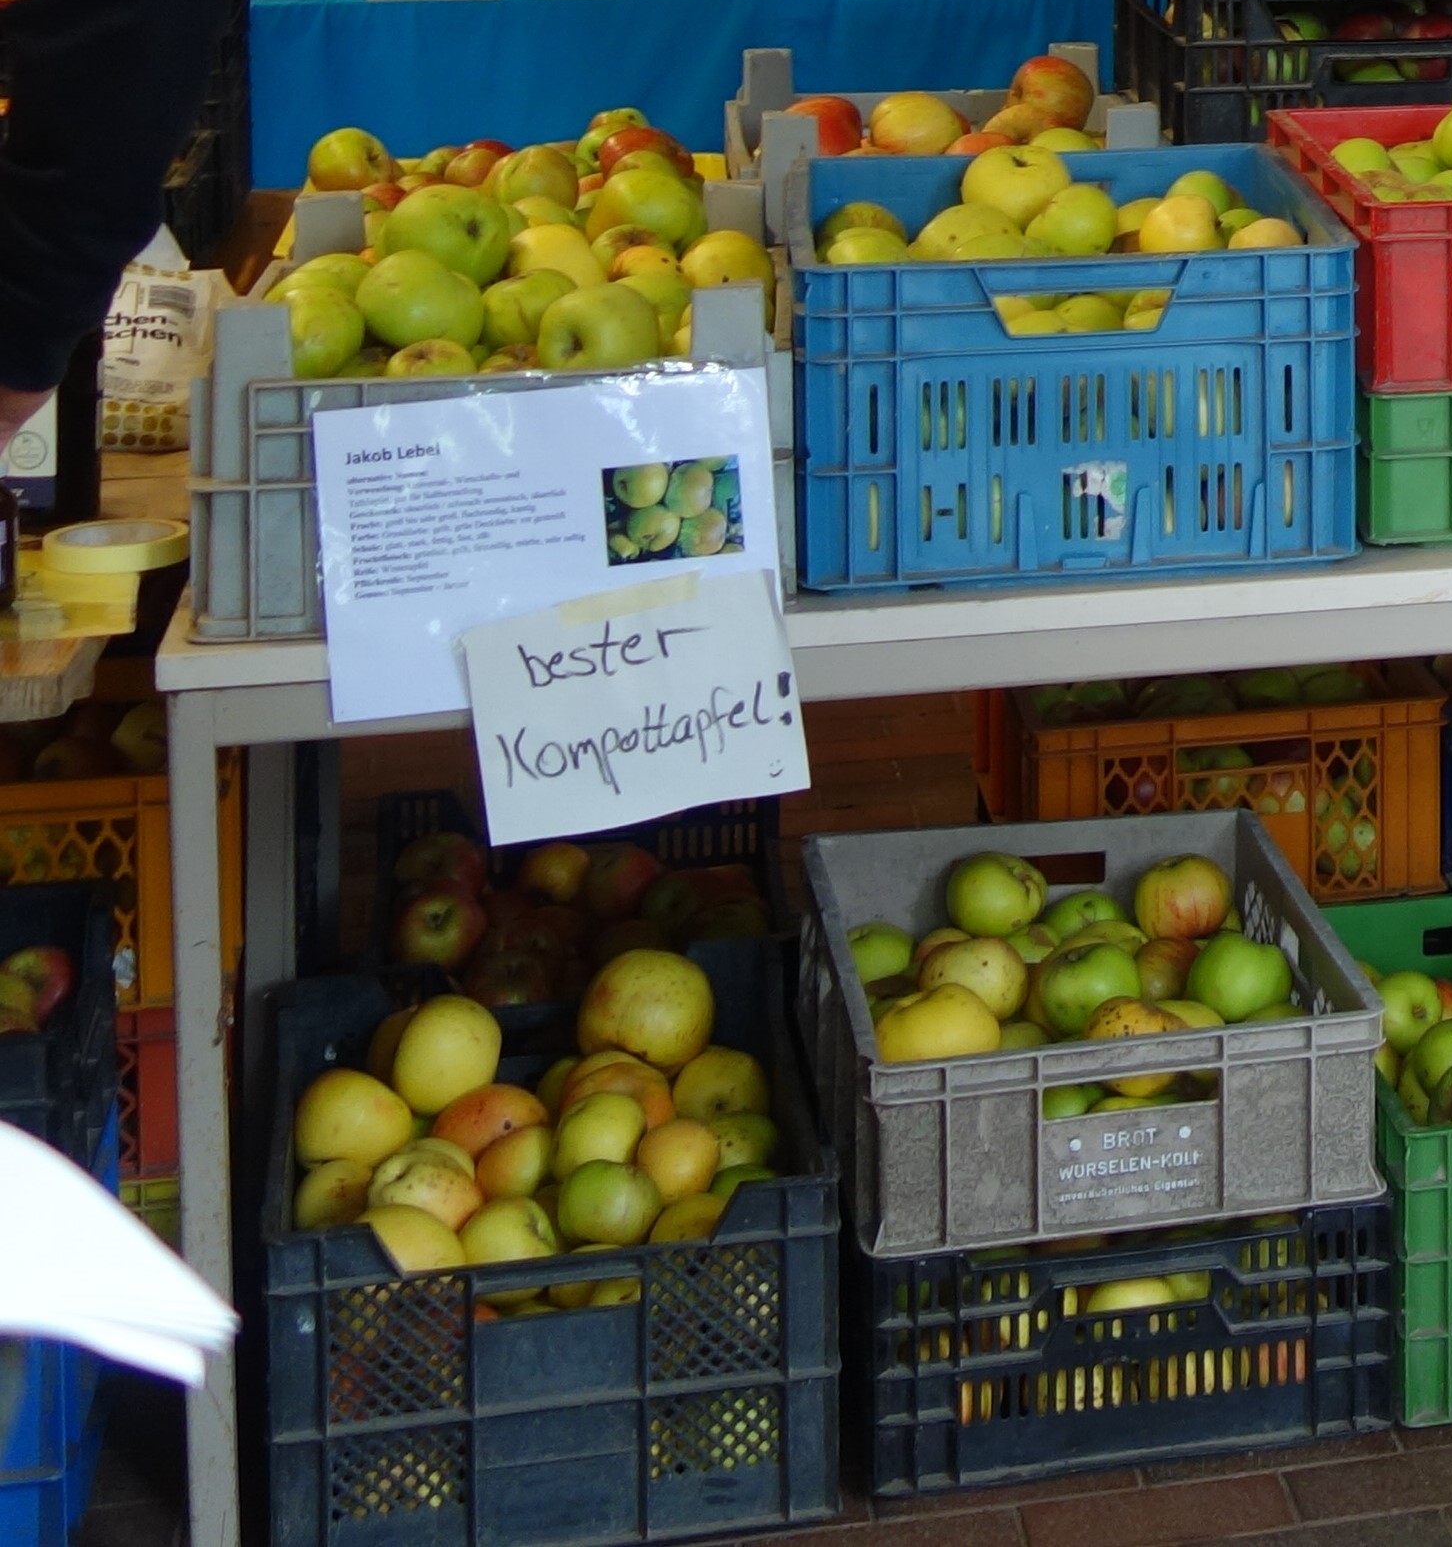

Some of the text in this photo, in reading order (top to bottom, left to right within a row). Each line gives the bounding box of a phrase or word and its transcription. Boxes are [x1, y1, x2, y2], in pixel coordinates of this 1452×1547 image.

[345, 444, 441, 466] Jakob Lebel
[516, 620, 712, 688] bester
[495, 669, 795, 797] Kompottapfel!
